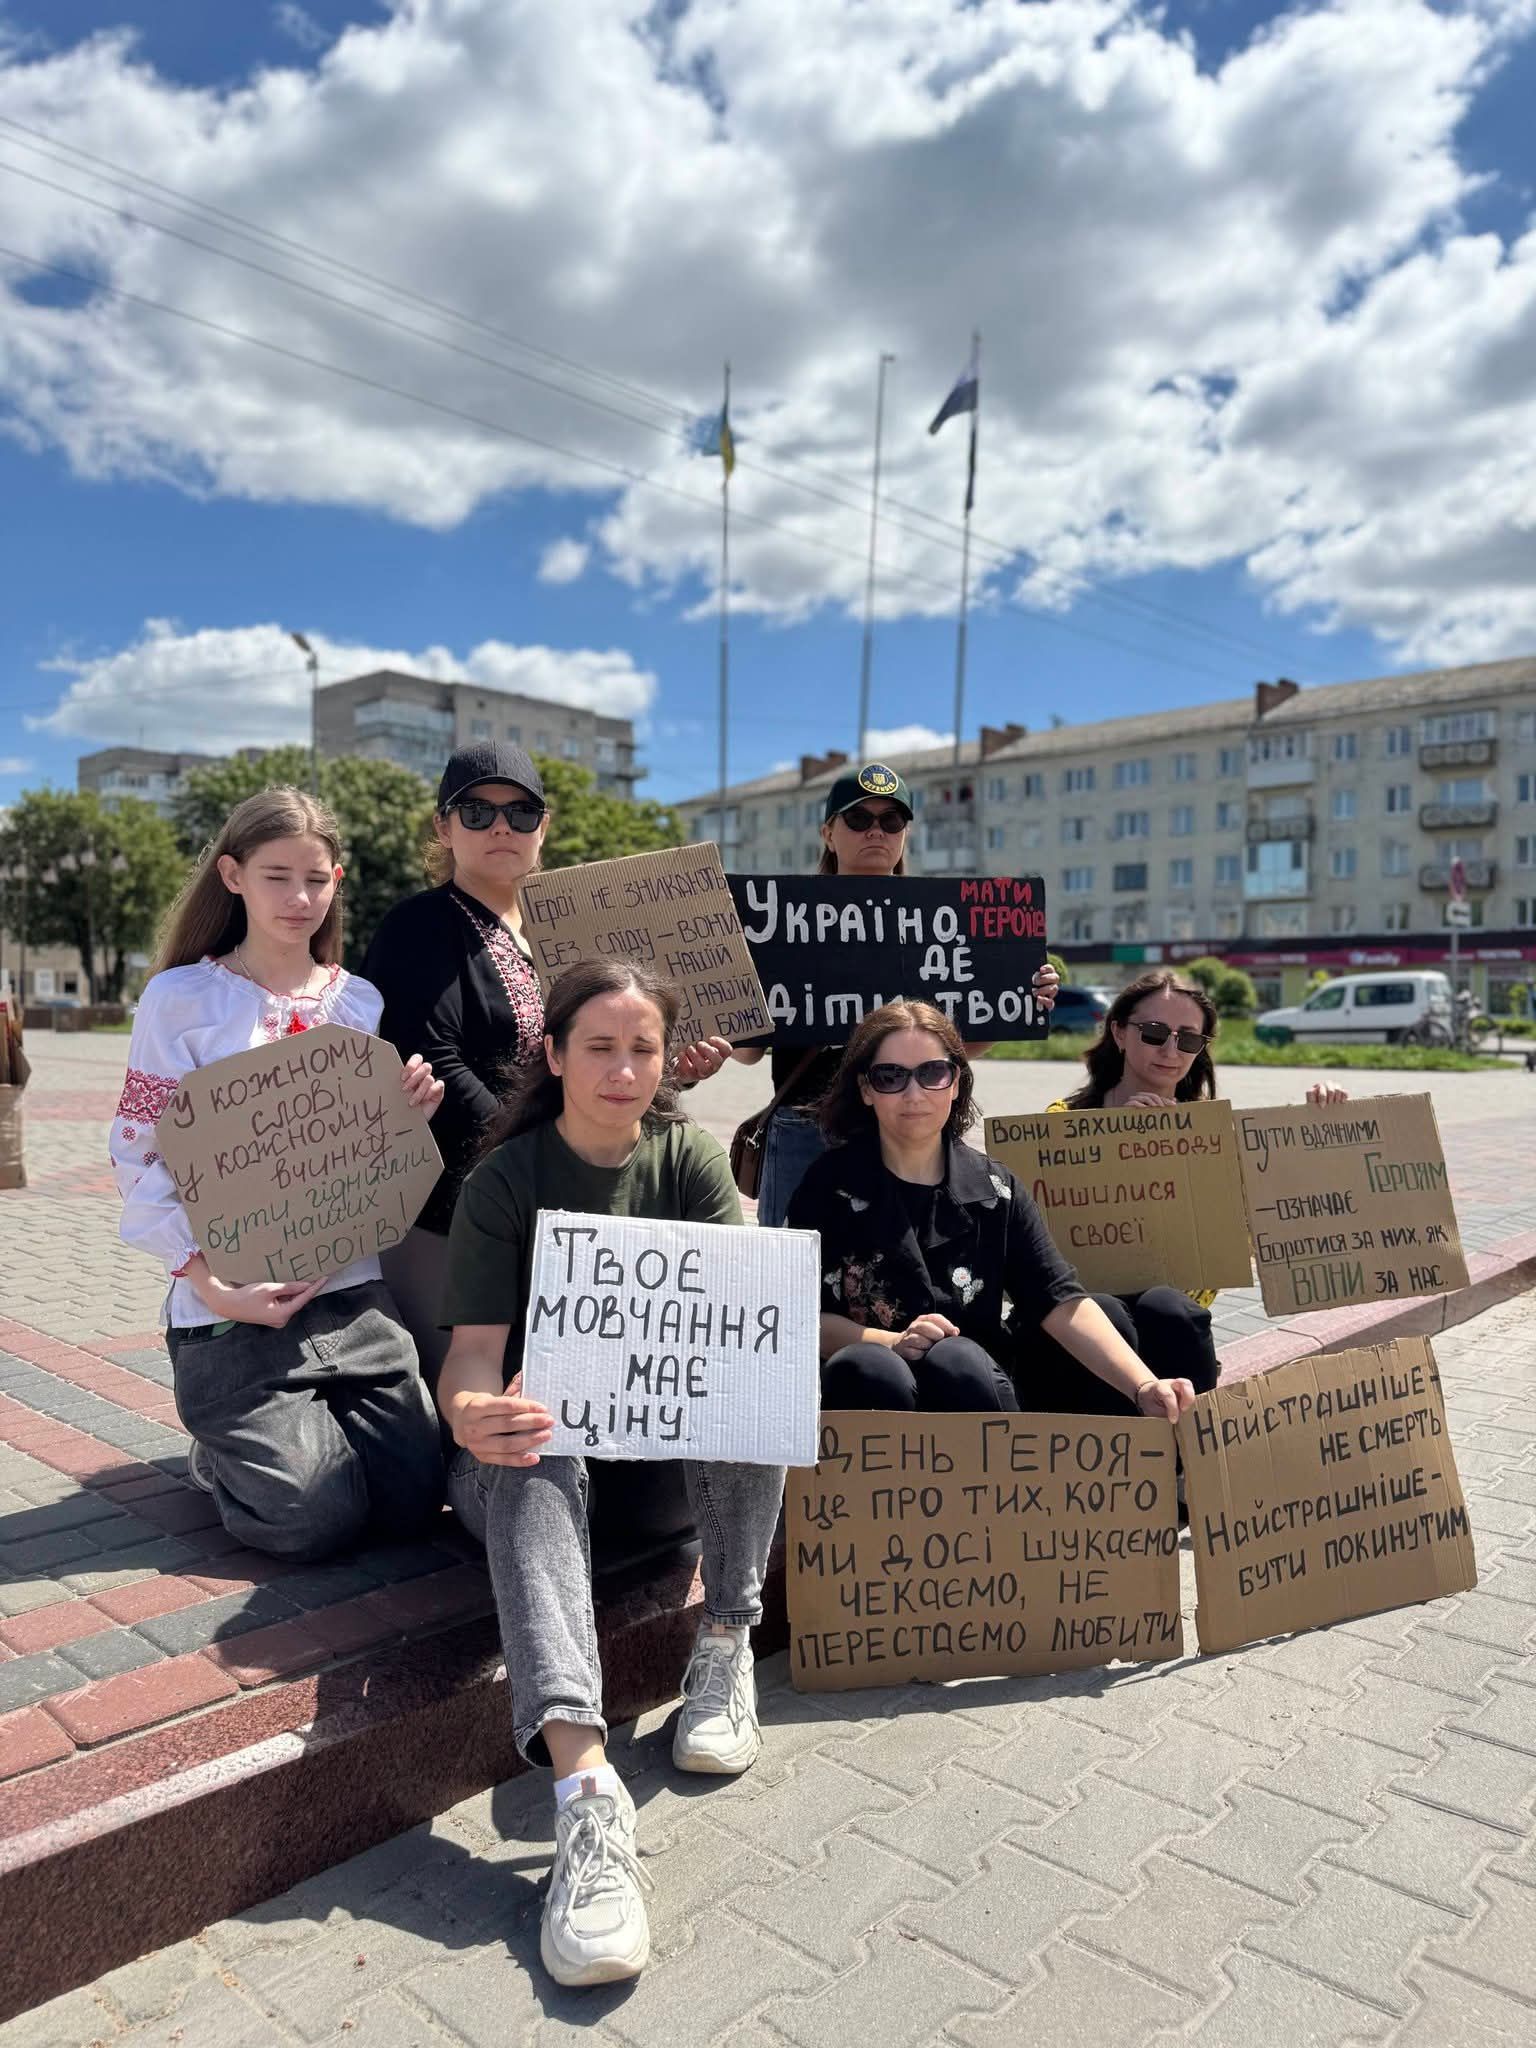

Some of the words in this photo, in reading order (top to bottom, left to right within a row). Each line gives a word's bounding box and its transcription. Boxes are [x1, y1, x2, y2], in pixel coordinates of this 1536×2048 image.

[591, 887, 615, 911] НЕ
[624, 867, 727, 908] ЗНИКАЮТЬ
[960, 877, 1033, 904] МАТИ
[969, 904, 1047, 938] ГЕРОЇВ
[919, 944, 975, 983] ДЕ
[1426, 1225, 1449, 1243] ЯК
[1292, 1261, 1365, 1307] ВОНИ
[1375, 1271, 1399, 1294] ЗА
[532, 1295, 780, 1353] МОВЧАННЯ
[814, 1425, 954, 1475] ДЕНЬ
[1319, 1431, 1351, 1466] НЕ
[1358, 1408, 1442, 1453] СМЕРТЬ
[871, 1486, 943, 1521] ПРО
[1066, 1480, 1158, 1516] КОГО
[798, 1541, 856, 1577] МИ
[1238, 1549, 1306, 1597] БУТИ
[1324, 1505, 1470, 1570] ПОКИНУТИМ
[1058, 1569, 1110, 1604] НЕ
[1050, 1611, 1180, 1653] ЛЮБИТИ
